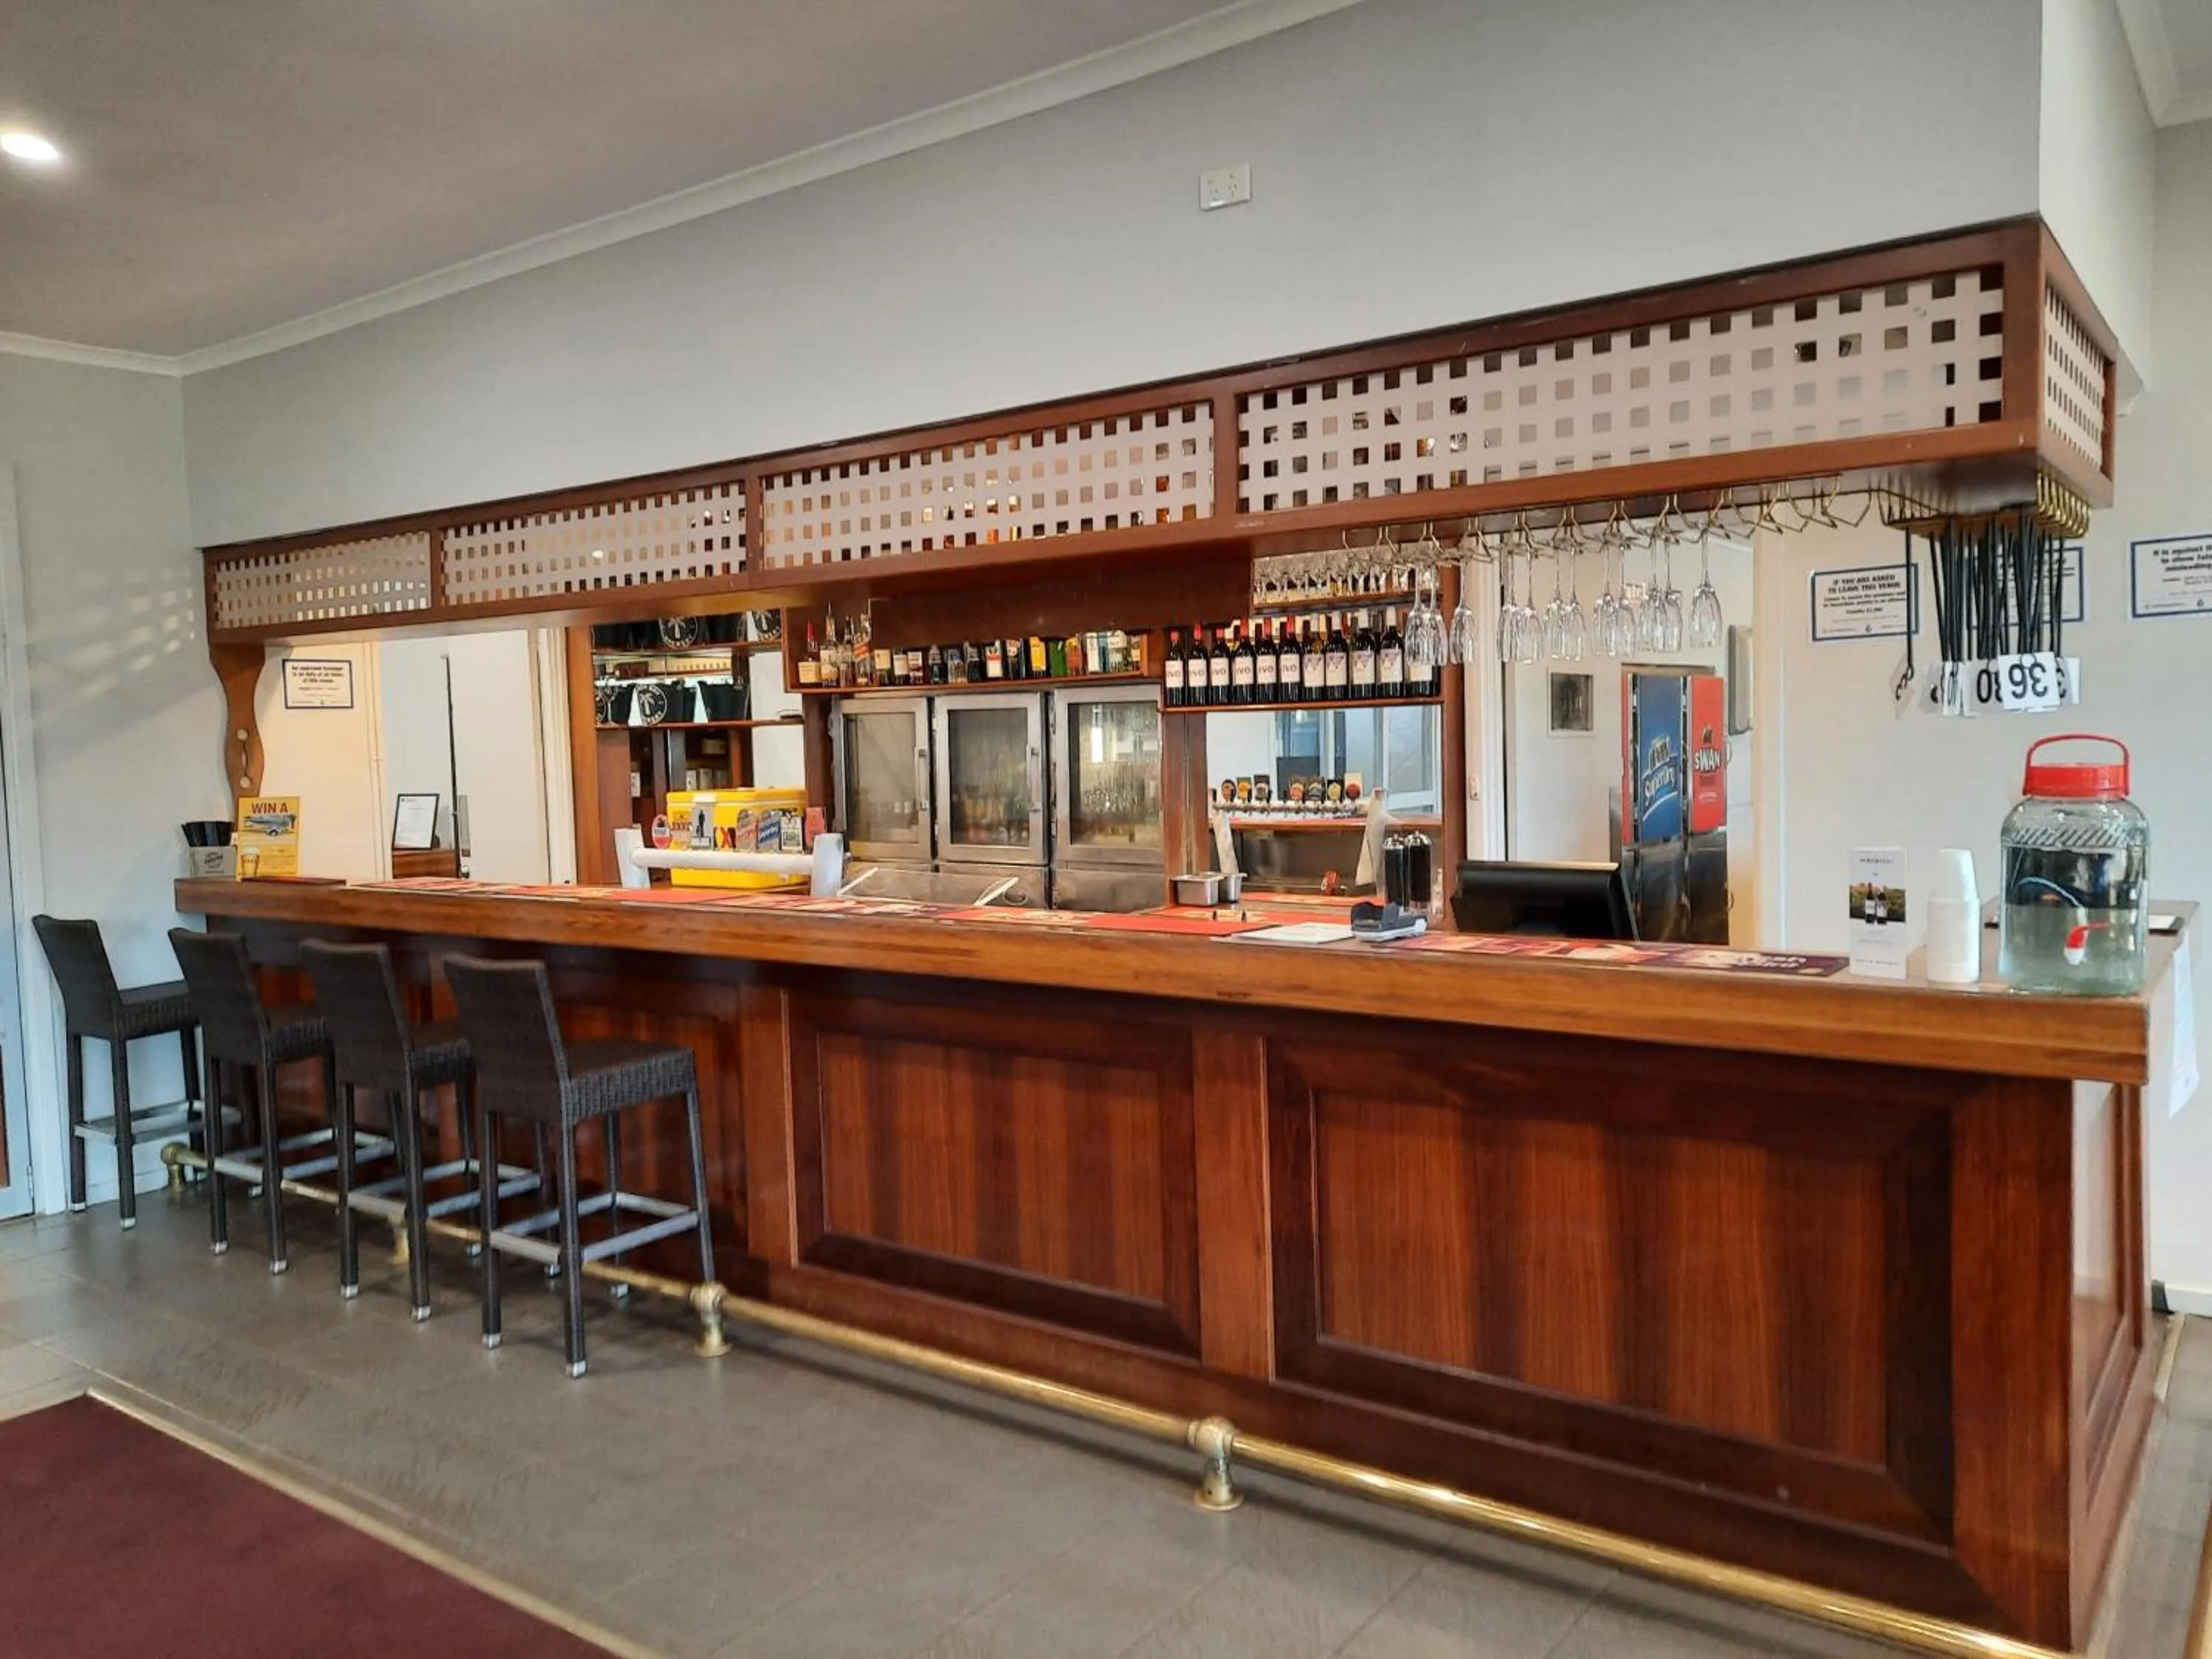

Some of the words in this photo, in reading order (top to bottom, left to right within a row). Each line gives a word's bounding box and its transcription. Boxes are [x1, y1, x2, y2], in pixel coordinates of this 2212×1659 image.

[1838, 585, 1860, 593] LEAVE
[2008, 663, 2048, 699] 36
[1694, 748, 1721, 771] SWAN
[251, 802, 276, 814] WIN
[279, 801, 288, 813] A
